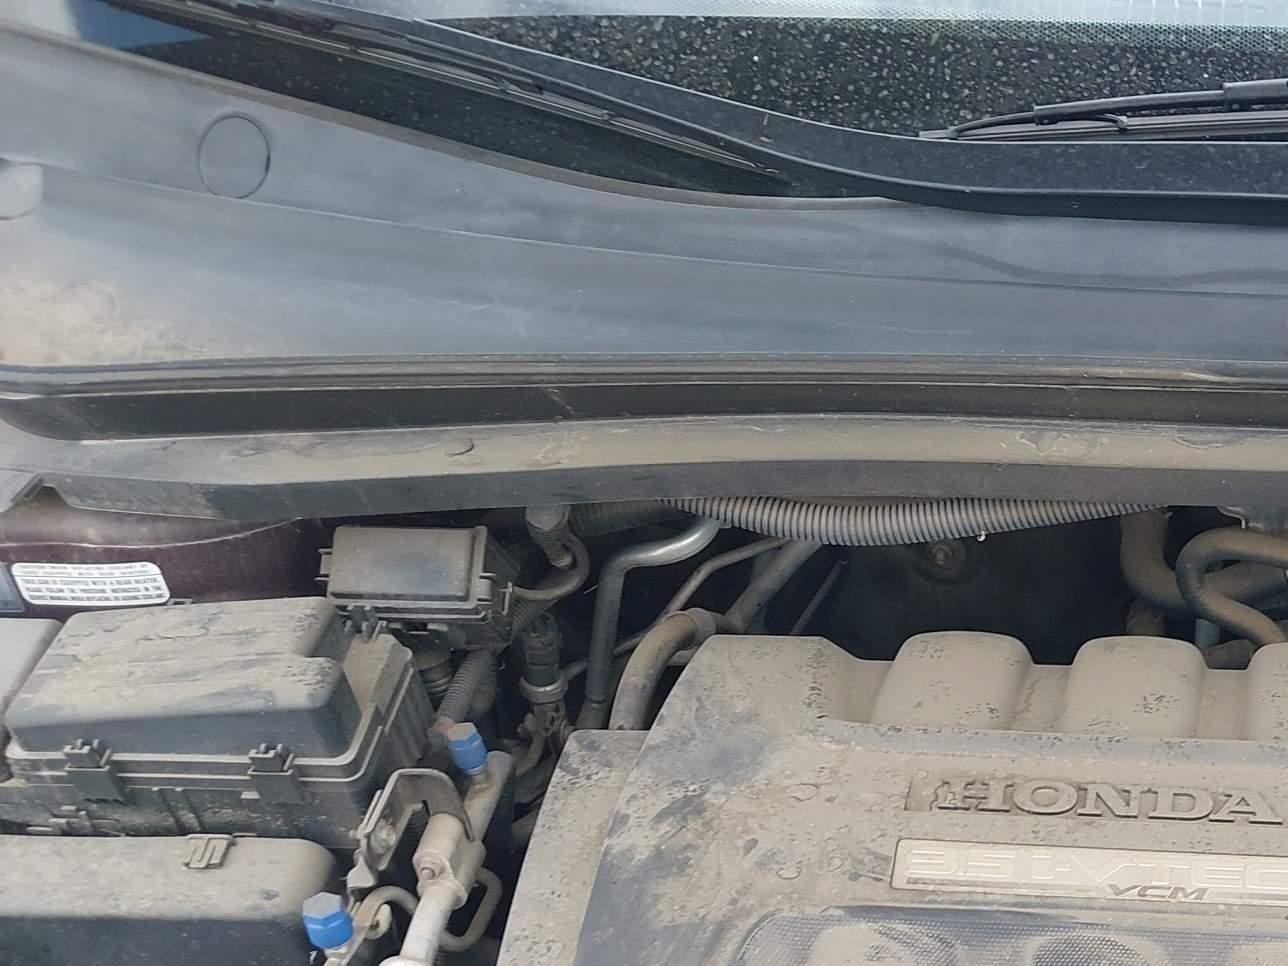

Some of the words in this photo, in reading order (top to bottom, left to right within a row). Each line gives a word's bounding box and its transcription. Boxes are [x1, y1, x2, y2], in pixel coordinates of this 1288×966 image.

[933, 780, 1284, 825] HONDA
[906, 848, 1016, 880] 3.5
[1107, 883, 1208, 900] VCM
